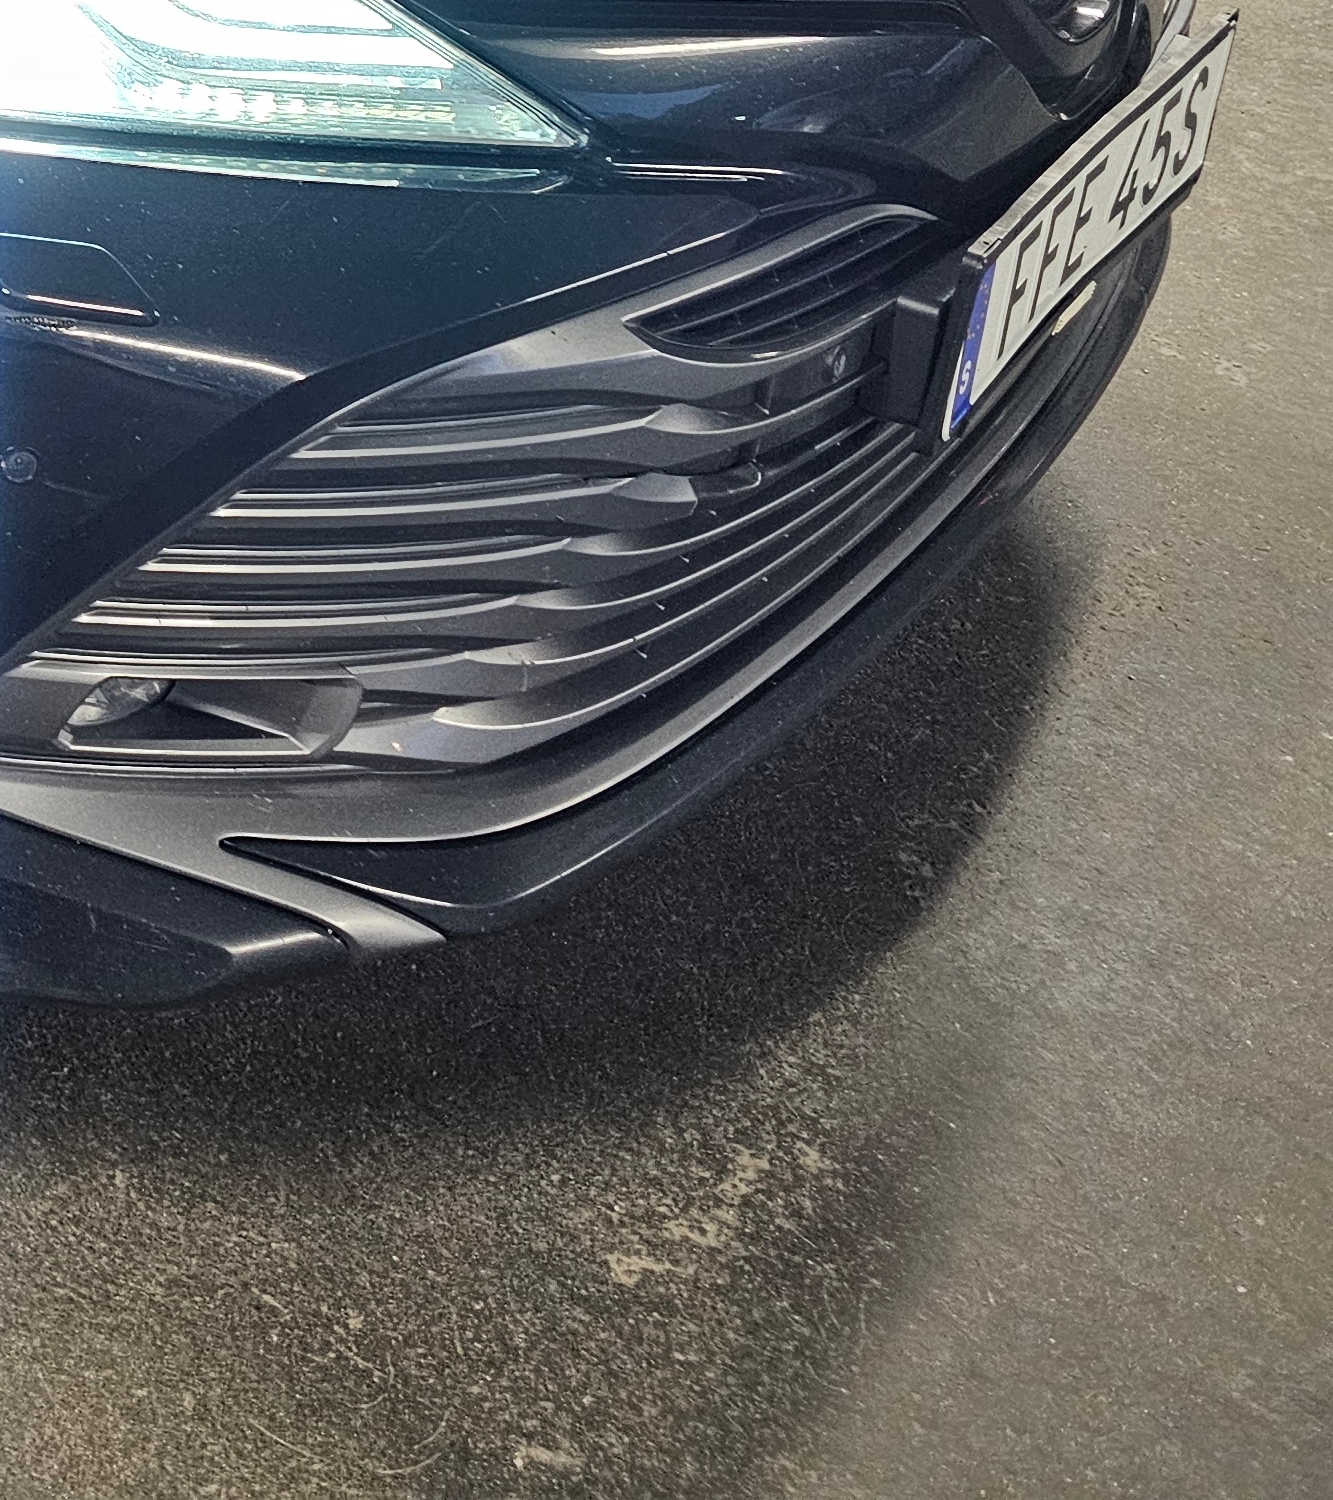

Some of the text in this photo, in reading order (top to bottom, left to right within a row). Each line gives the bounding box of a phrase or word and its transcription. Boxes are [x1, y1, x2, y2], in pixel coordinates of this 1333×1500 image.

[959, 66, 1209, 395] S FFE 45S
